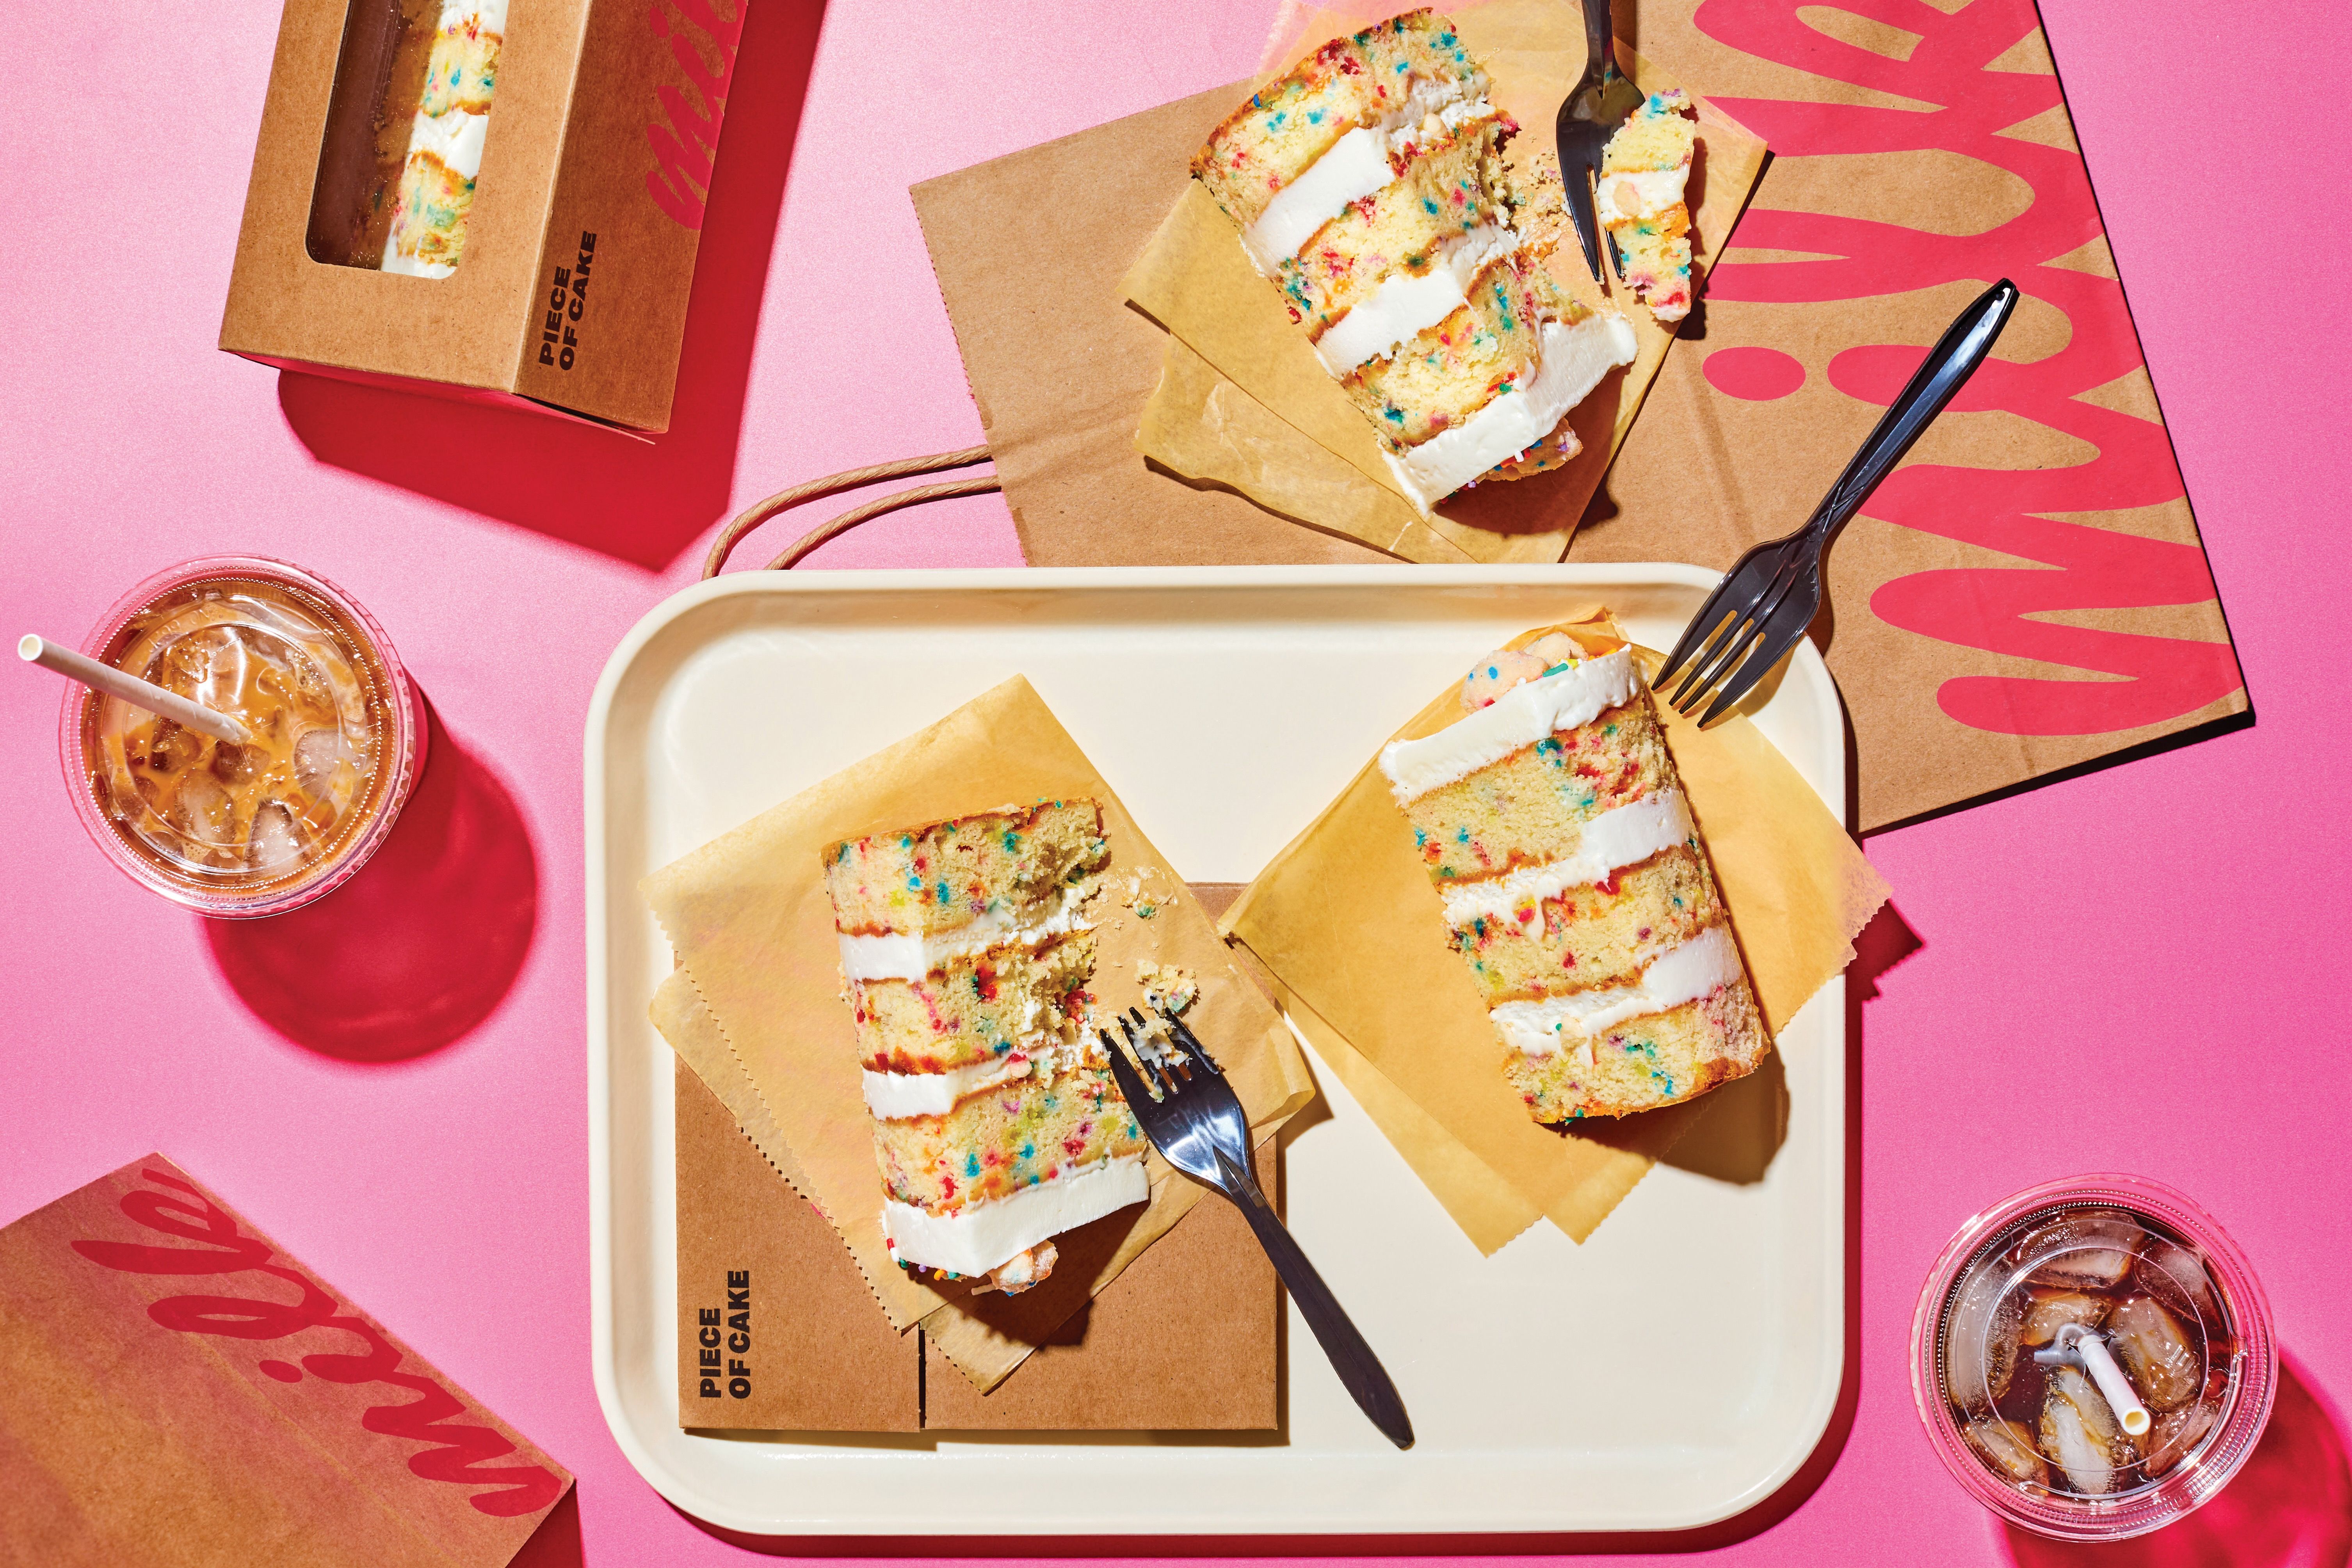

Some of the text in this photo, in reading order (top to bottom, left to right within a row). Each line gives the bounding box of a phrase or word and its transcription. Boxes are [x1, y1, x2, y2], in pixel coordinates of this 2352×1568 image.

[539, 266, 571, 366] PIECE
[559, 231, 597, 370] OF CAKE
[71, 1168, 562, 1517] milk
[699, 1308, 721, 1398] PIECE
[728, 1270, 751, 1399] OF CAKE
